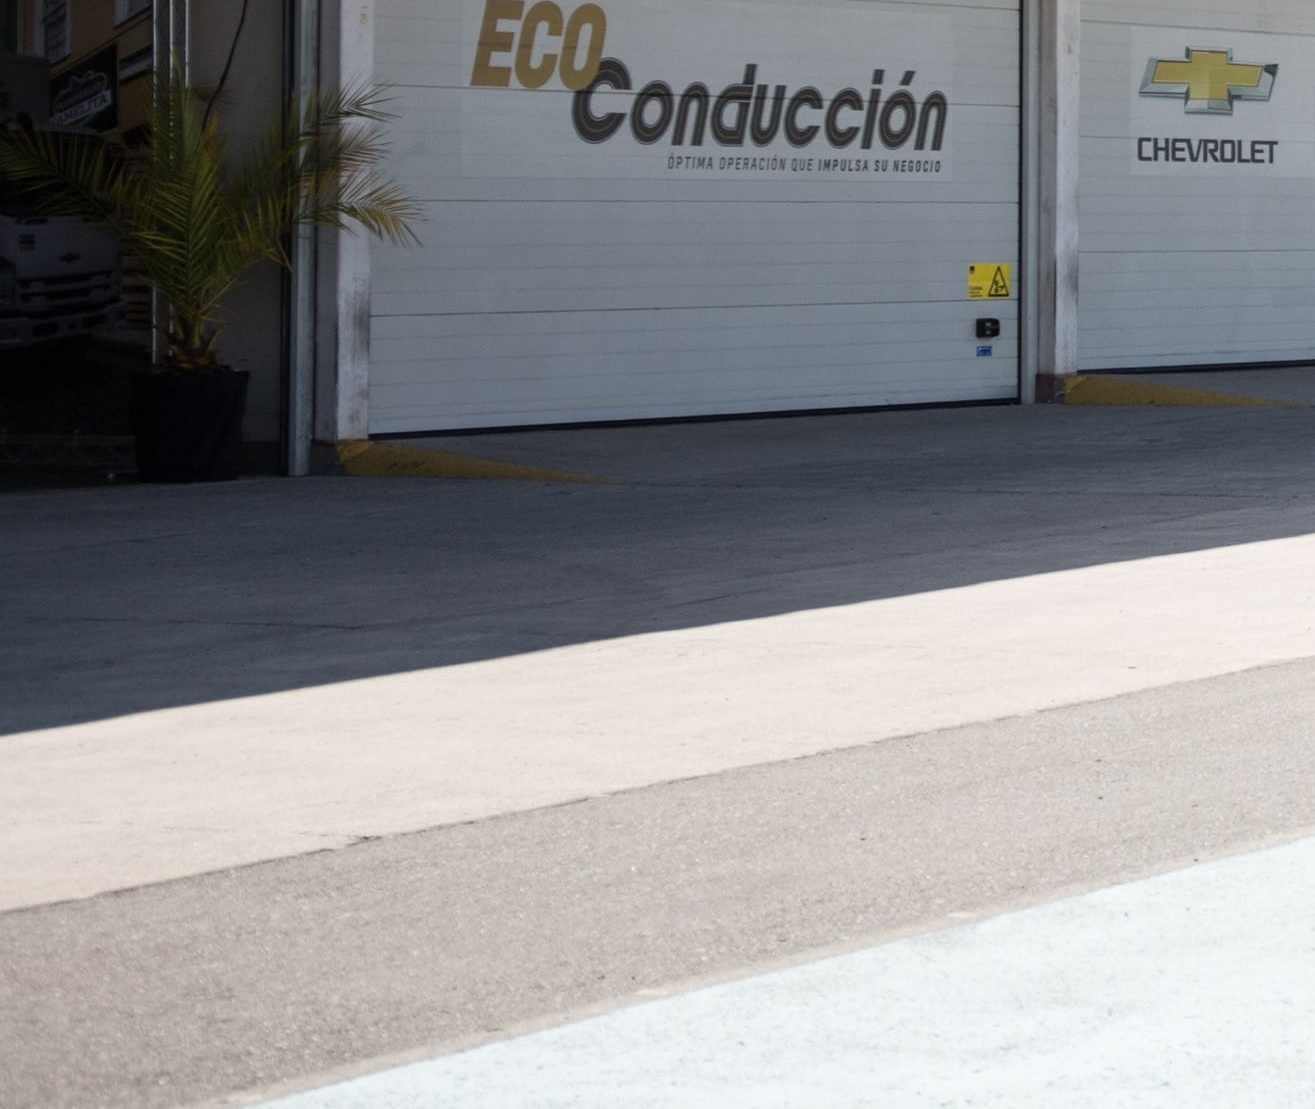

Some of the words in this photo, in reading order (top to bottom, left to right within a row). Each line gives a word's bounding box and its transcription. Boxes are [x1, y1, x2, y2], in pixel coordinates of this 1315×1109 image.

[571, 57, 948, 152] Conducción
[667, 152, 714, 171] ÓPTIMA
[719, 154, 786, 172] OPERACIÓN
[791, 157, 813, 172] QUE
[818, 158, 869, 172] IMPULSA
[874, 159, 888, 172] SU
[893, 159, 941, 173] NEGOCIO
[1136, 137, 1279, 165] CHEVROLET
